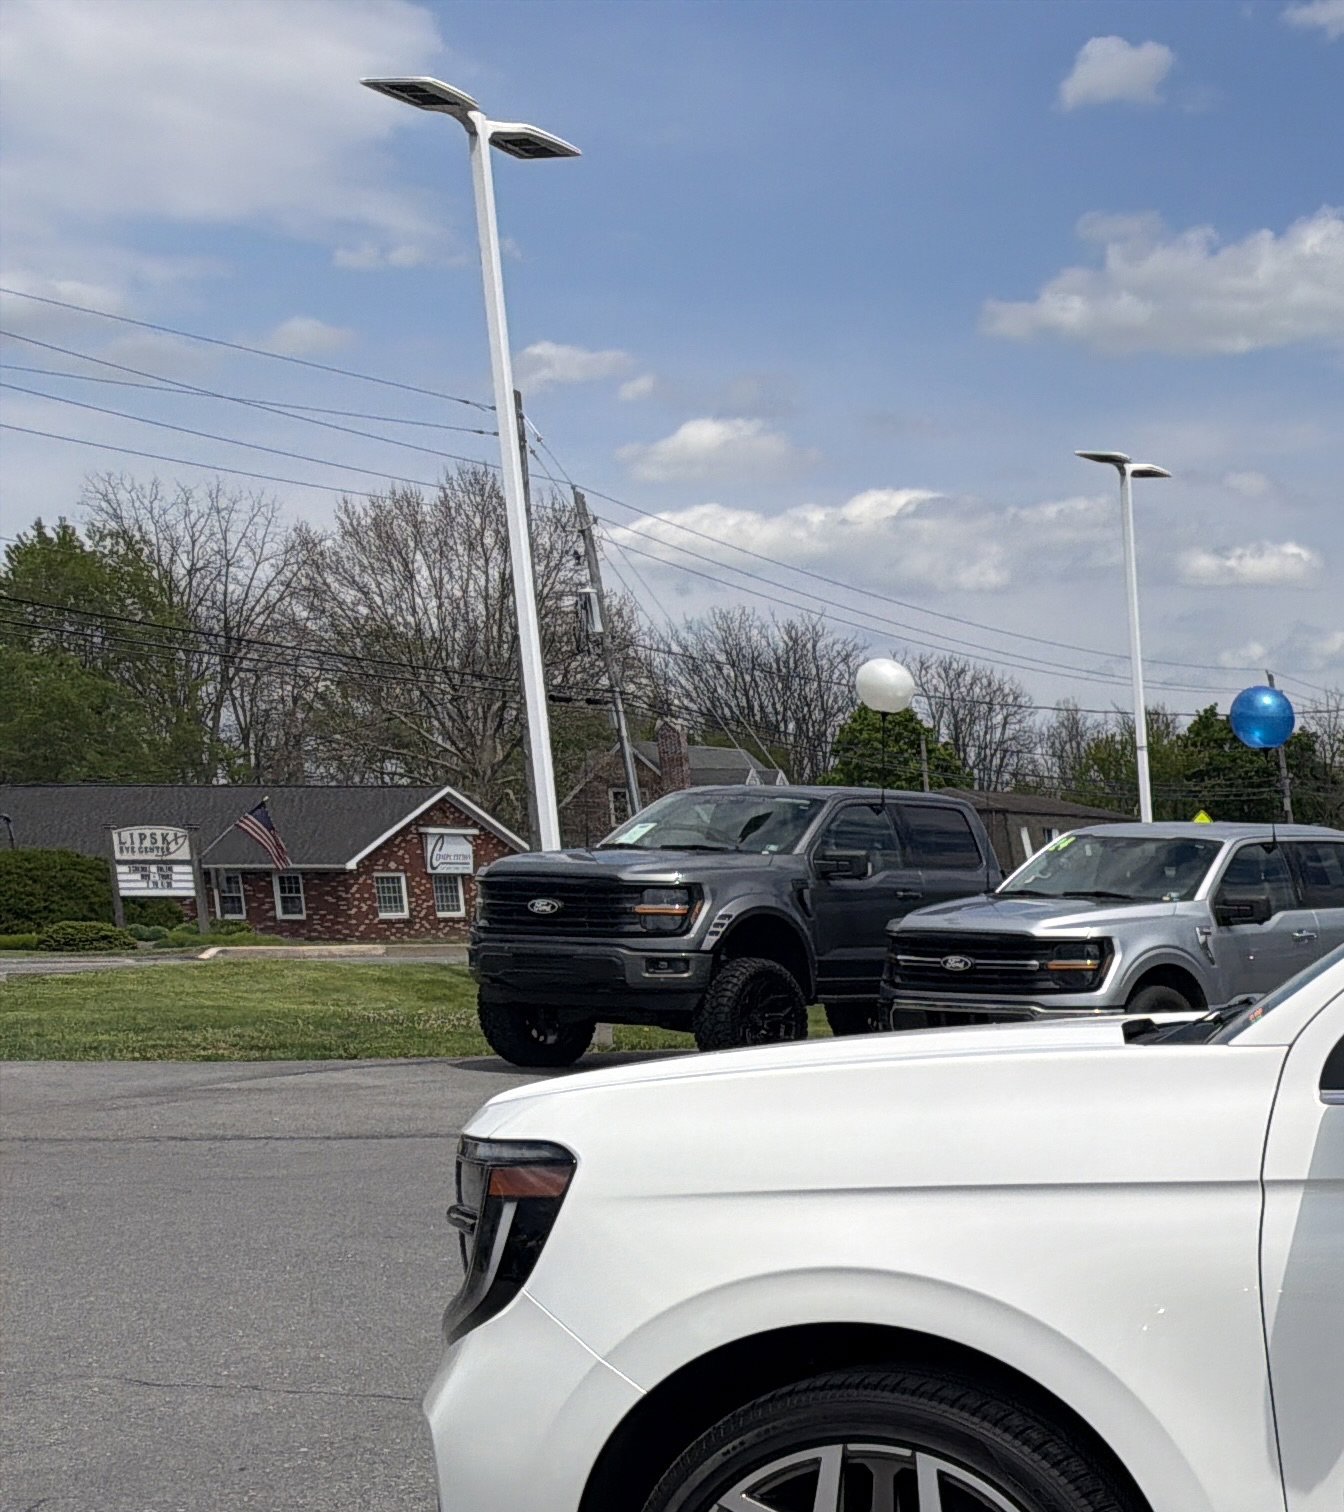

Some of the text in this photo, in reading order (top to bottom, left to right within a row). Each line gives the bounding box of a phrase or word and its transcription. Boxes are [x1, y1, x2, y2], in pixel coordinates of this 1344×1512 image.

[117, 831, 180, 846] LIPSKI
[532, 900, 554, 912] Ford
[944, 957, 967, 969] Ford
